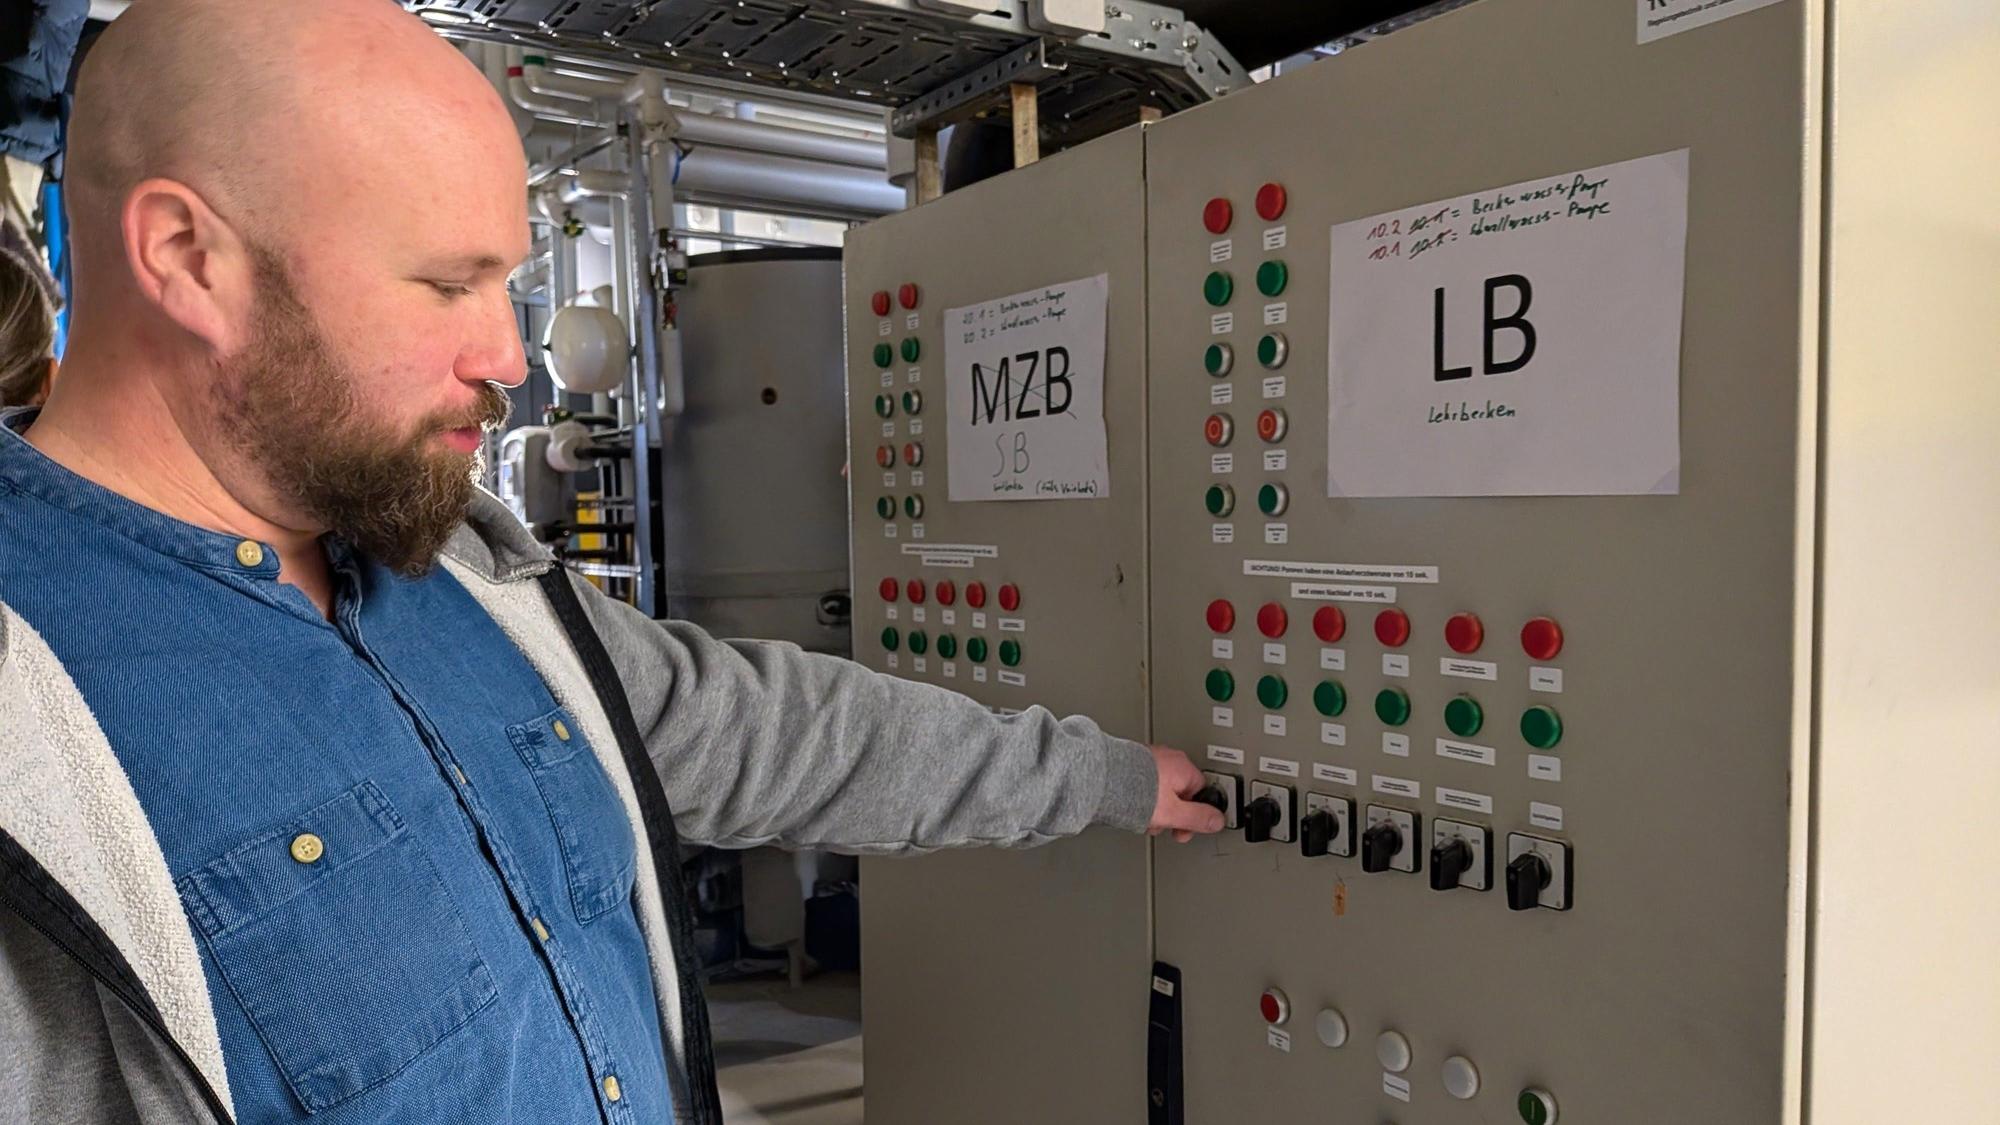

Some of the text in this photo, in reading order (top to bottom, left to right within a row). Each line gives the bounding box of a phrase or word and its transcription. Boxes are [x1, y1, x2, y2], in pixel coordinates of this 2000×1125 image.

[1367, 219, 1401, 240] 10.2
[1368, 241, 1400, 260] 10.1
[1434, 274, 1537, 382] LB
[971, 346, 1073, 426] MZB
[1428, 400, 1516, 424] Lehrbecken
